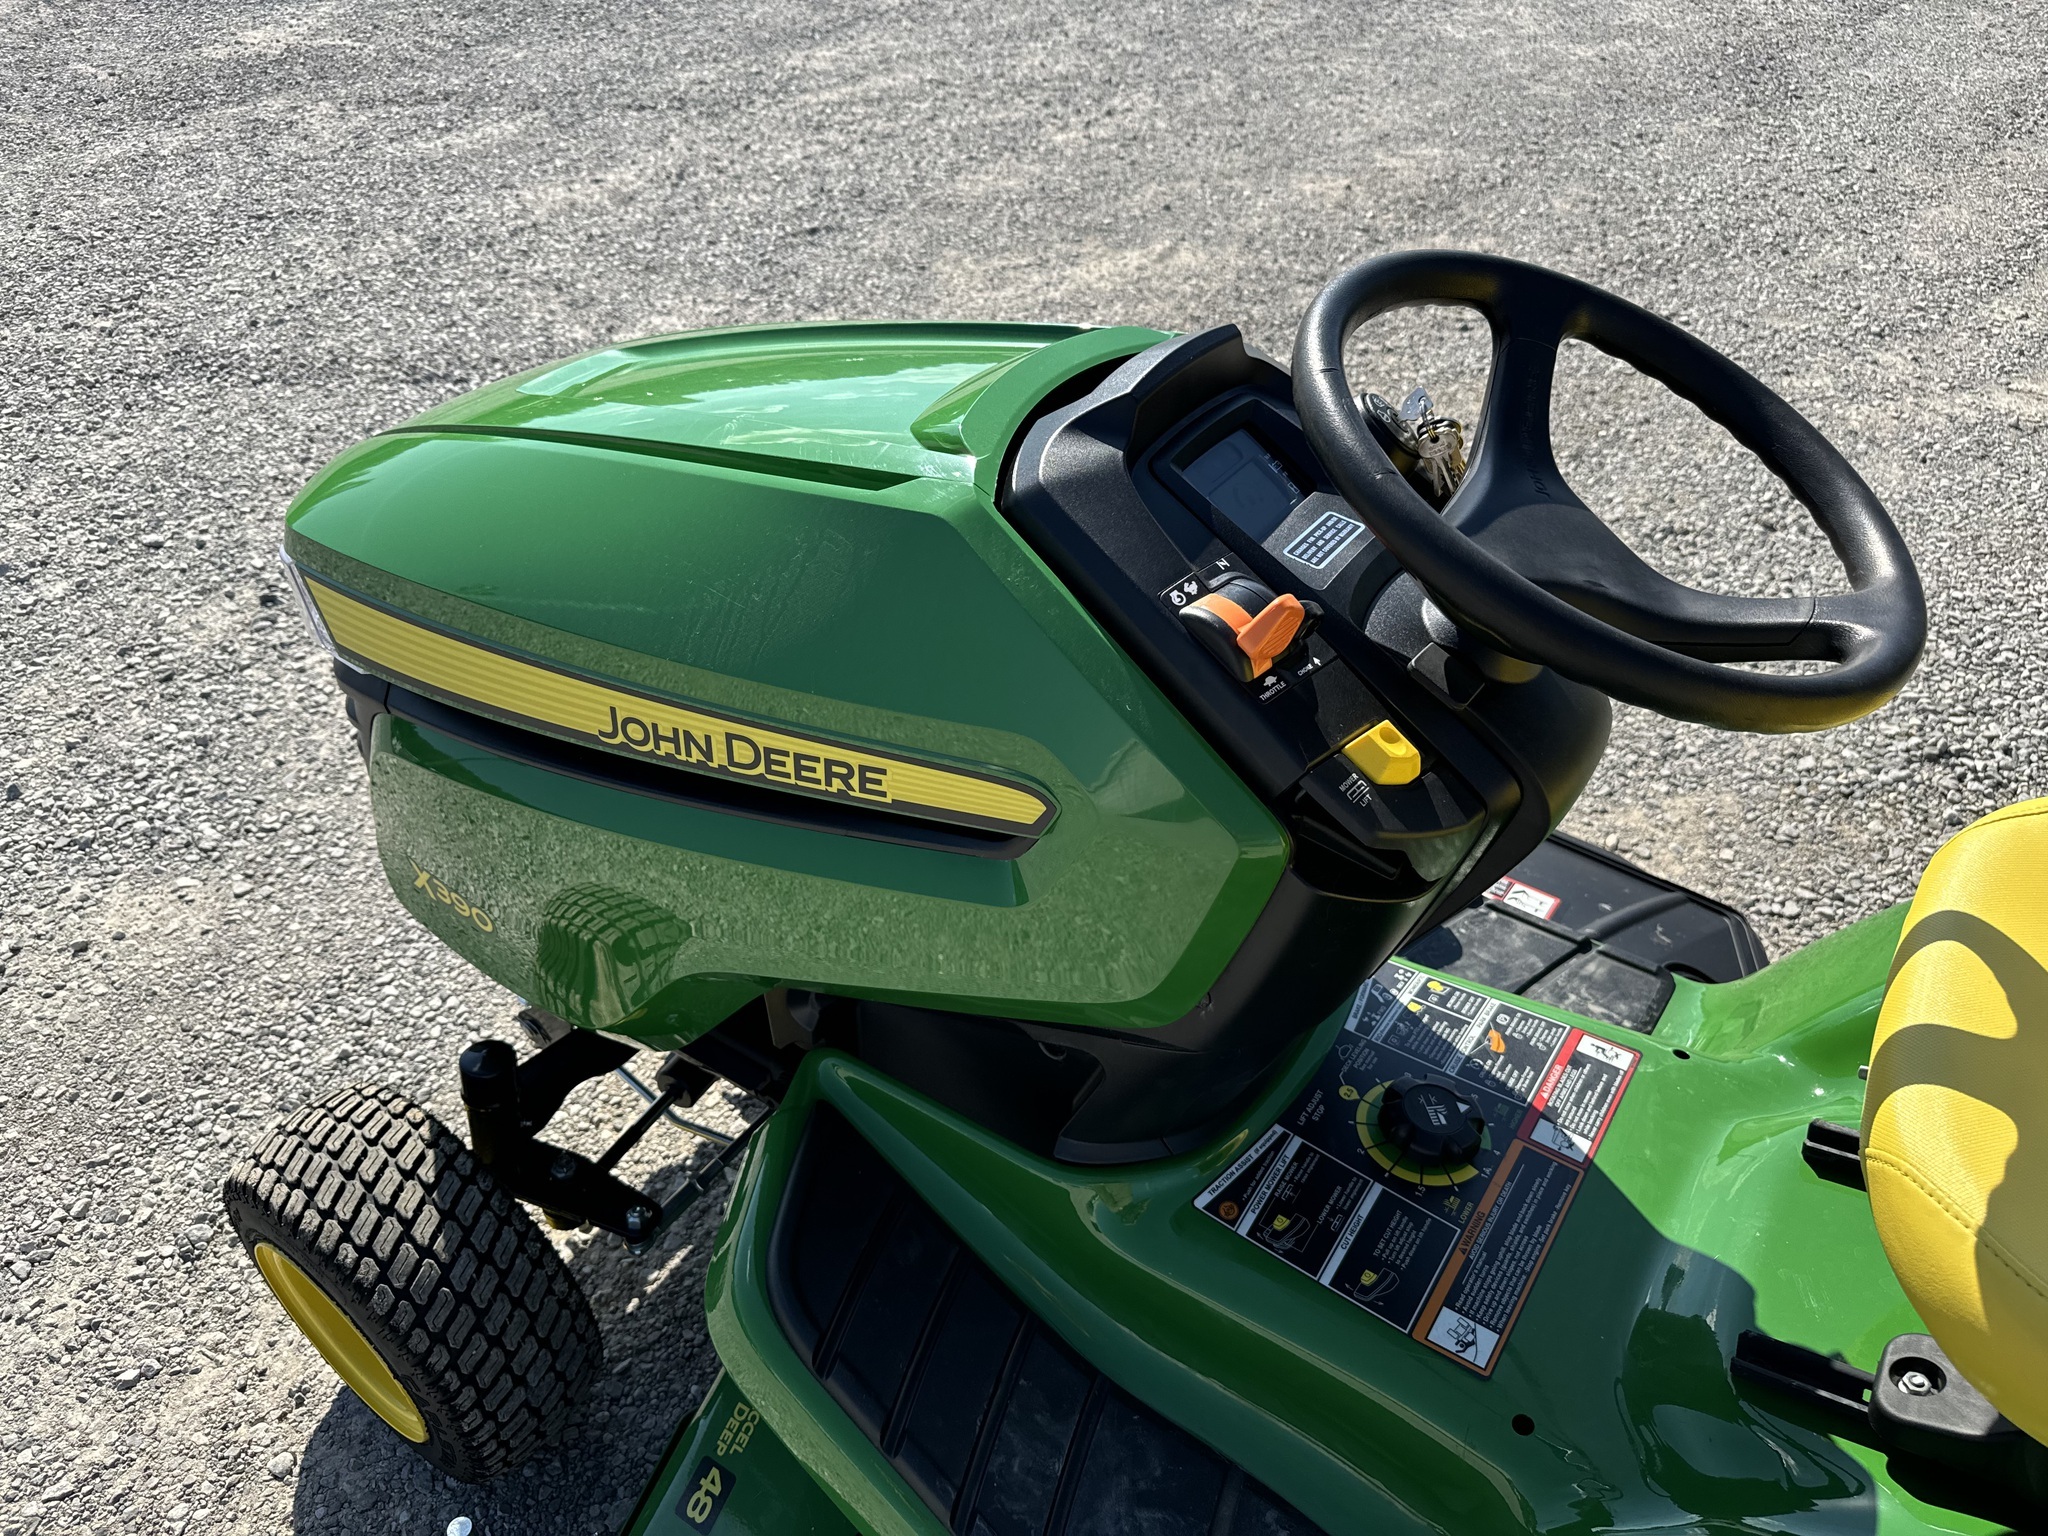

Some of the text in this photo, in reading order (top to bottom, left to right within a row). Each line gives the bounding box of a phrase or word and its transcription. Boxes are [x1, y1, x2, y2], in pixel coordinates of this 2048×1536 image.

[1259, 680, 1287, 702] THROTTLE
[598, 705, 889, 798] JOHN DEERE
[1338, 772, 1359, 793] MOWER
[1359, 793, 1373, 808] LIFT
[1340, 1038, 1366, 1072] DECK LEVELING
[1352, 1047, 1370, 1068] POSITION
[1342, 1087, 1354, 1097] 2.5
[1542, 1063, 1563, 1093] DANGER
[1296, 1089, 1324, 1125] LIFT ADJUST
[1311, 1104, 1326, 1121] STOP
[1206, 1169, 1235, 1195] TRACTION
[1234, 1153, 1254, 1171] ASSIST
[1250, 1153, 1289, 1214] POWER MOWER LIFT
[1273, 1161, 1298, 1196] RAISE MOWER
[1414, 1184, 1427, 1197] 1.5
[1316, 1185, 1342, 1224] LOWER MOWER
[1457, 1200, 1474, 1224] LOWER
[1467, 1243, 1480, 1260] AVOID
[1475, 1221, 1491, 1244] SERIOUS
[1486, 1204, 1500, 1222] INJURY
[1499, 1180, 1512, 1197] DEATH
[1339, 1213, 1364, 1250] CUT HEIGHT
[1376, 1237, 1386, 1249] SET
[1382, 1227, 1392, 1238] CUT
[1388, 1209, 1402, 1228] HEIGHT
[1460, 1210, 1485, 1247] WARNING
[716, 1402, 749, 1457] DEEP
[729, 1408, 760, 1455] CCEL
[686, 1467, 722, 1524] 48
